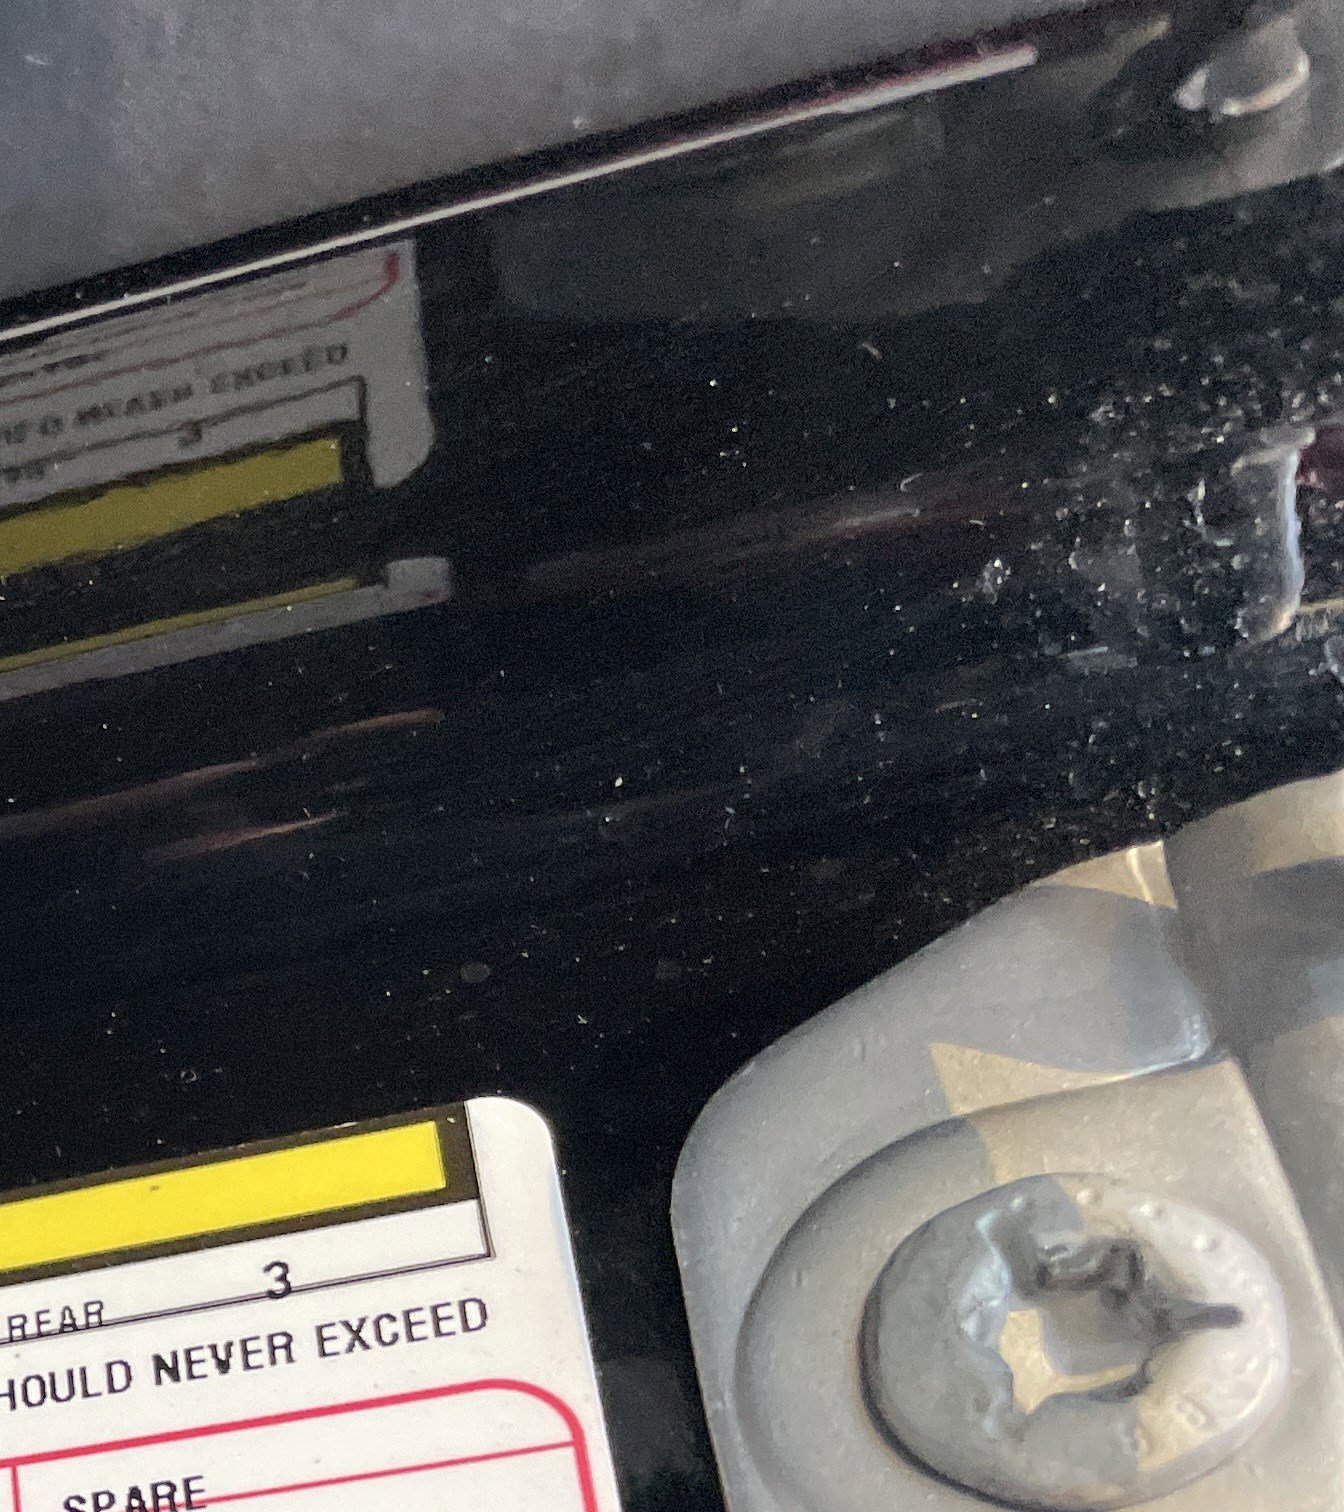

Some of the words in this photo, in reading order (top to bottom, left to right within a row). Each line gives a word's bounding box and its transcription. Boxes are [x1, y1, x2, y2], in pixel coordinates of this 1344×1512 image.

[5, 1300, 107, 1344] REAR
[262, 1262, 293, 1298] 3
[150, 1329, 297, 1387] NEVER
[314, 1294, 489, 1357] EXCEED
